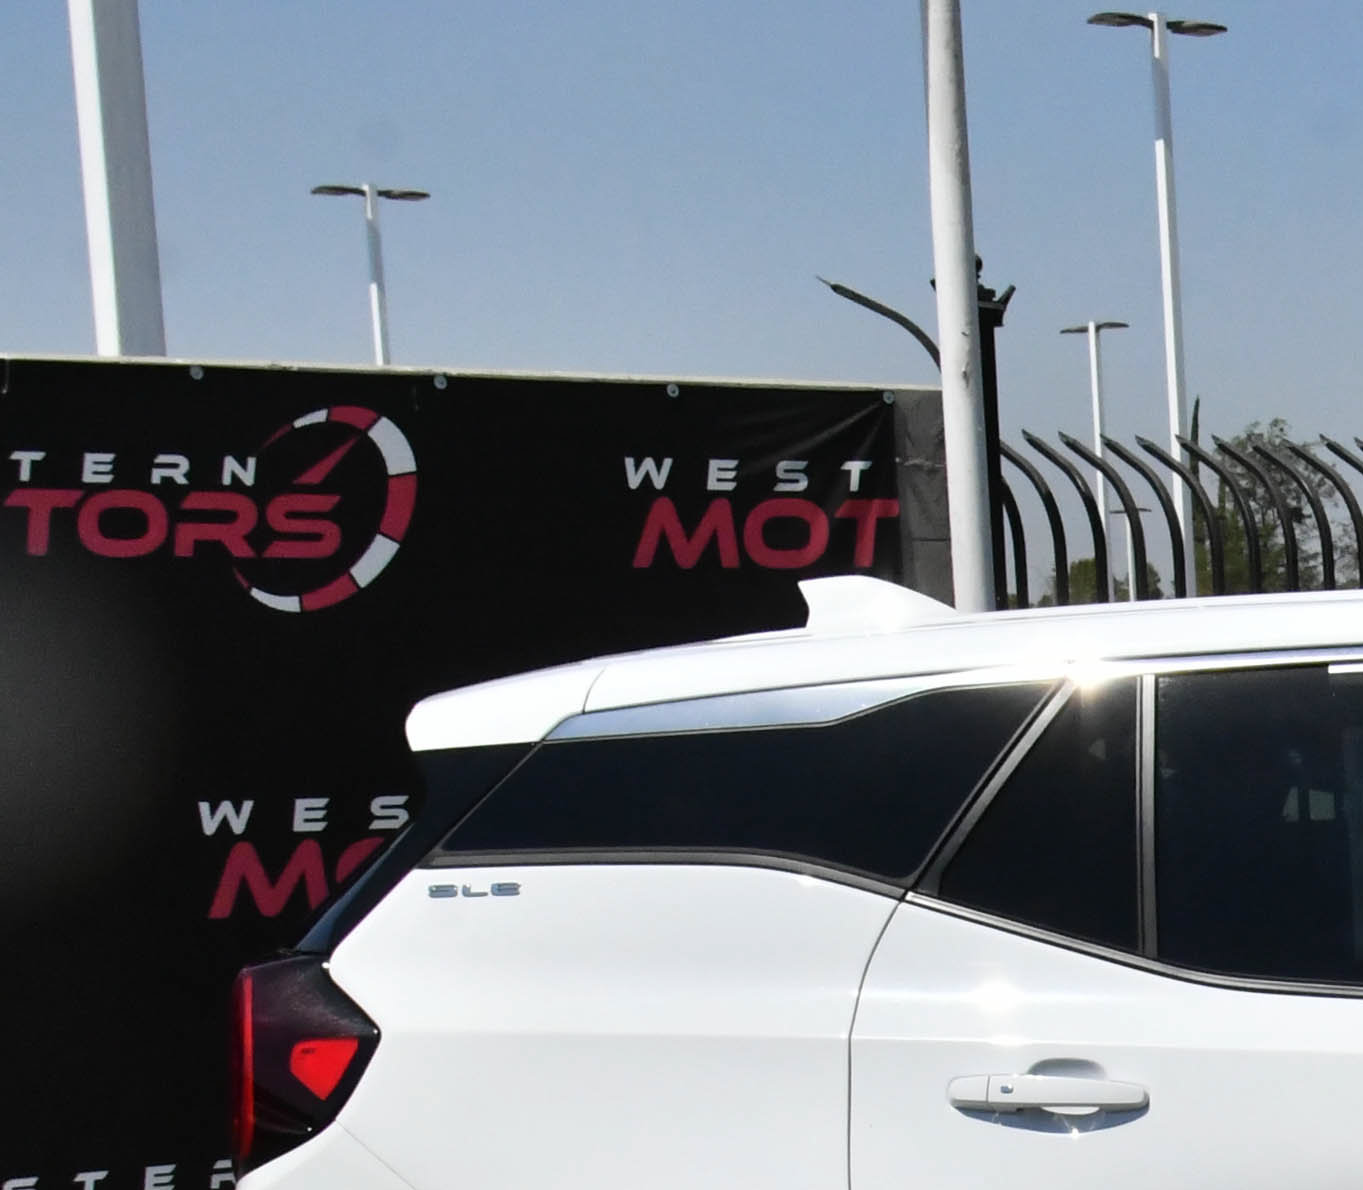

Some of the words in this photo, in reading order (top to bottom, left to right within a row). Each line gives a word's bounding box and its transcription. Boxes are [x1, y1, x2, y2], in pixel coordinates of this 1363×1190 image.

[624, 456, 873, 492] WEST
[632, 496, 900, 569] MOT
[198, 795, 410, 836] WES
[208, 836, 385, 919] M
[428, 883, 521, 899] SLE
